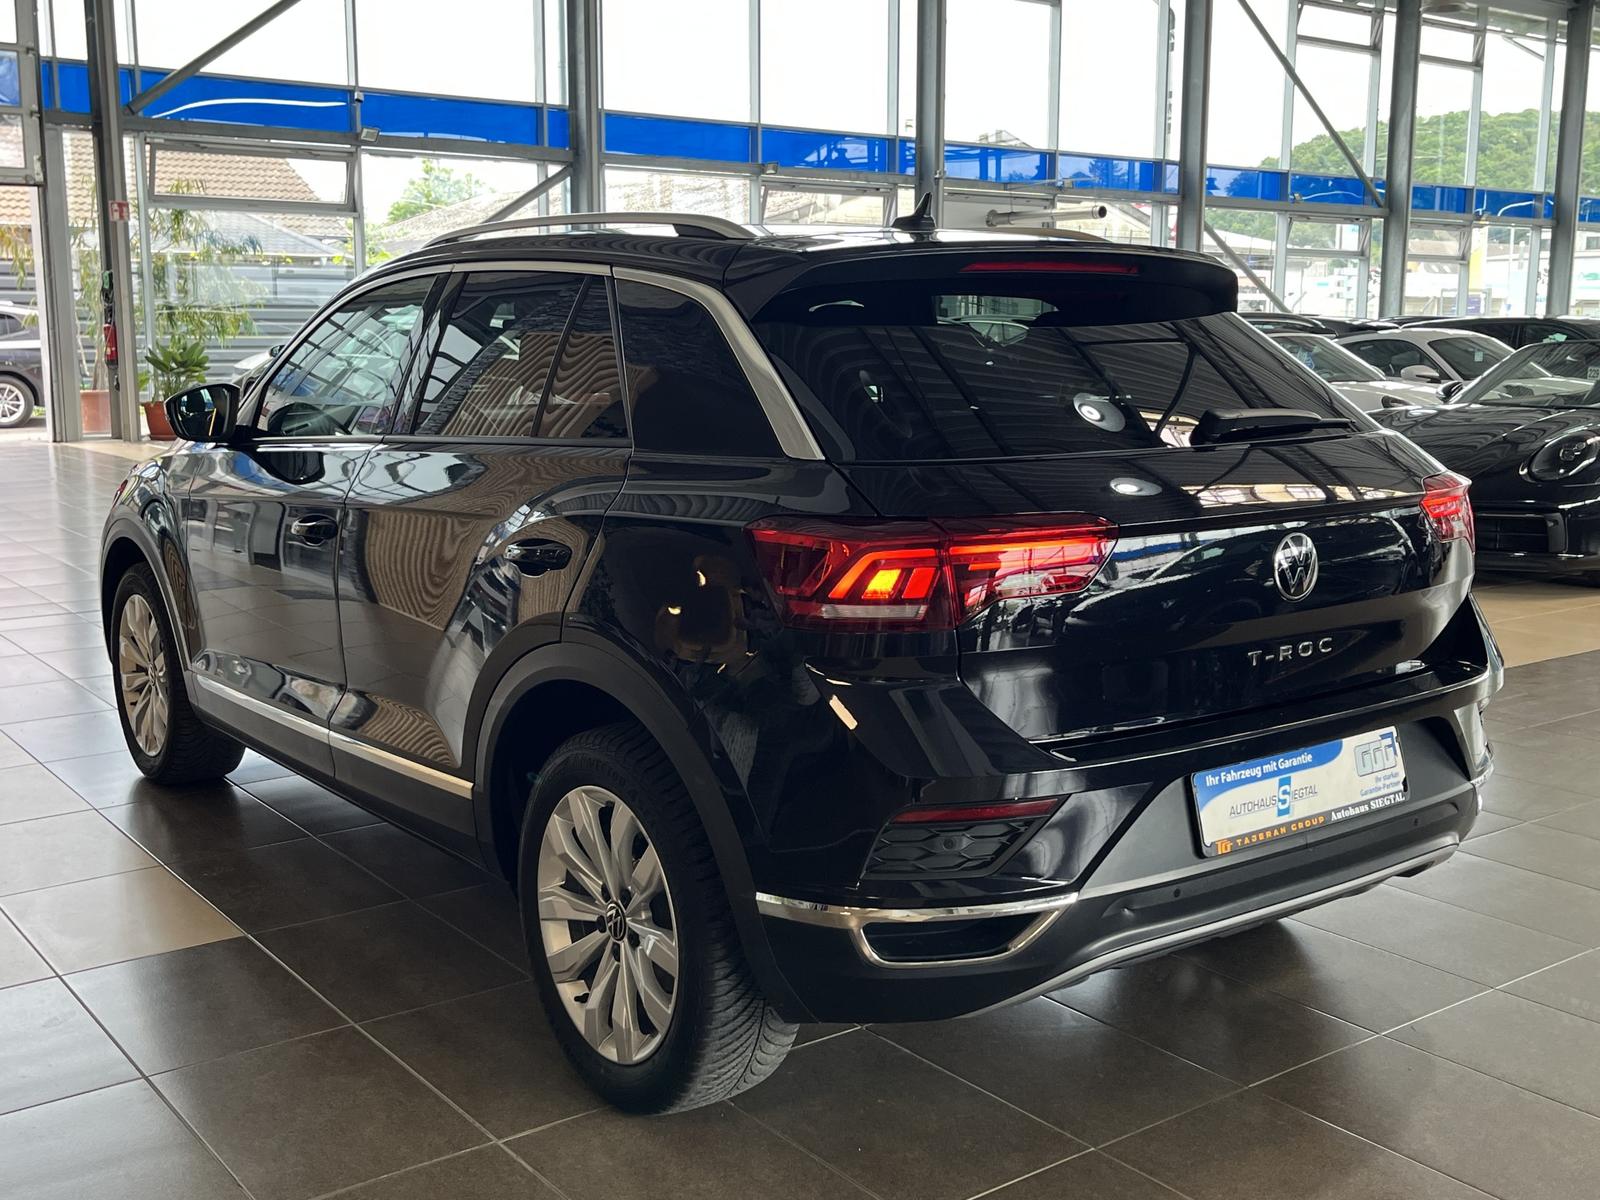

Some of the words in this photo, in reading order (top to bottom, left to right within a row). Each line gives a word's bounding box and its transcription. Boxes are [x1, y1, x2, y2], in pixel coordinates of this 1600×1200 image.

[1248, 637, 1333, 667] T-ROC
[1206, 775, 1220, 787] Ihr
[1221, 766, 1262, 784] Fahrzeug
[1263, 761, 1278, 773] mit
[1278, 752, 1313, 769] Garantie
[1229, 795, 1277, 816] AUTOHAUS
[1331, 803, 1370, 821] Autohaus
[1370, 792, 1406, 810] SIEGTAL
[1290, 816, 1325, 832] GROUP
